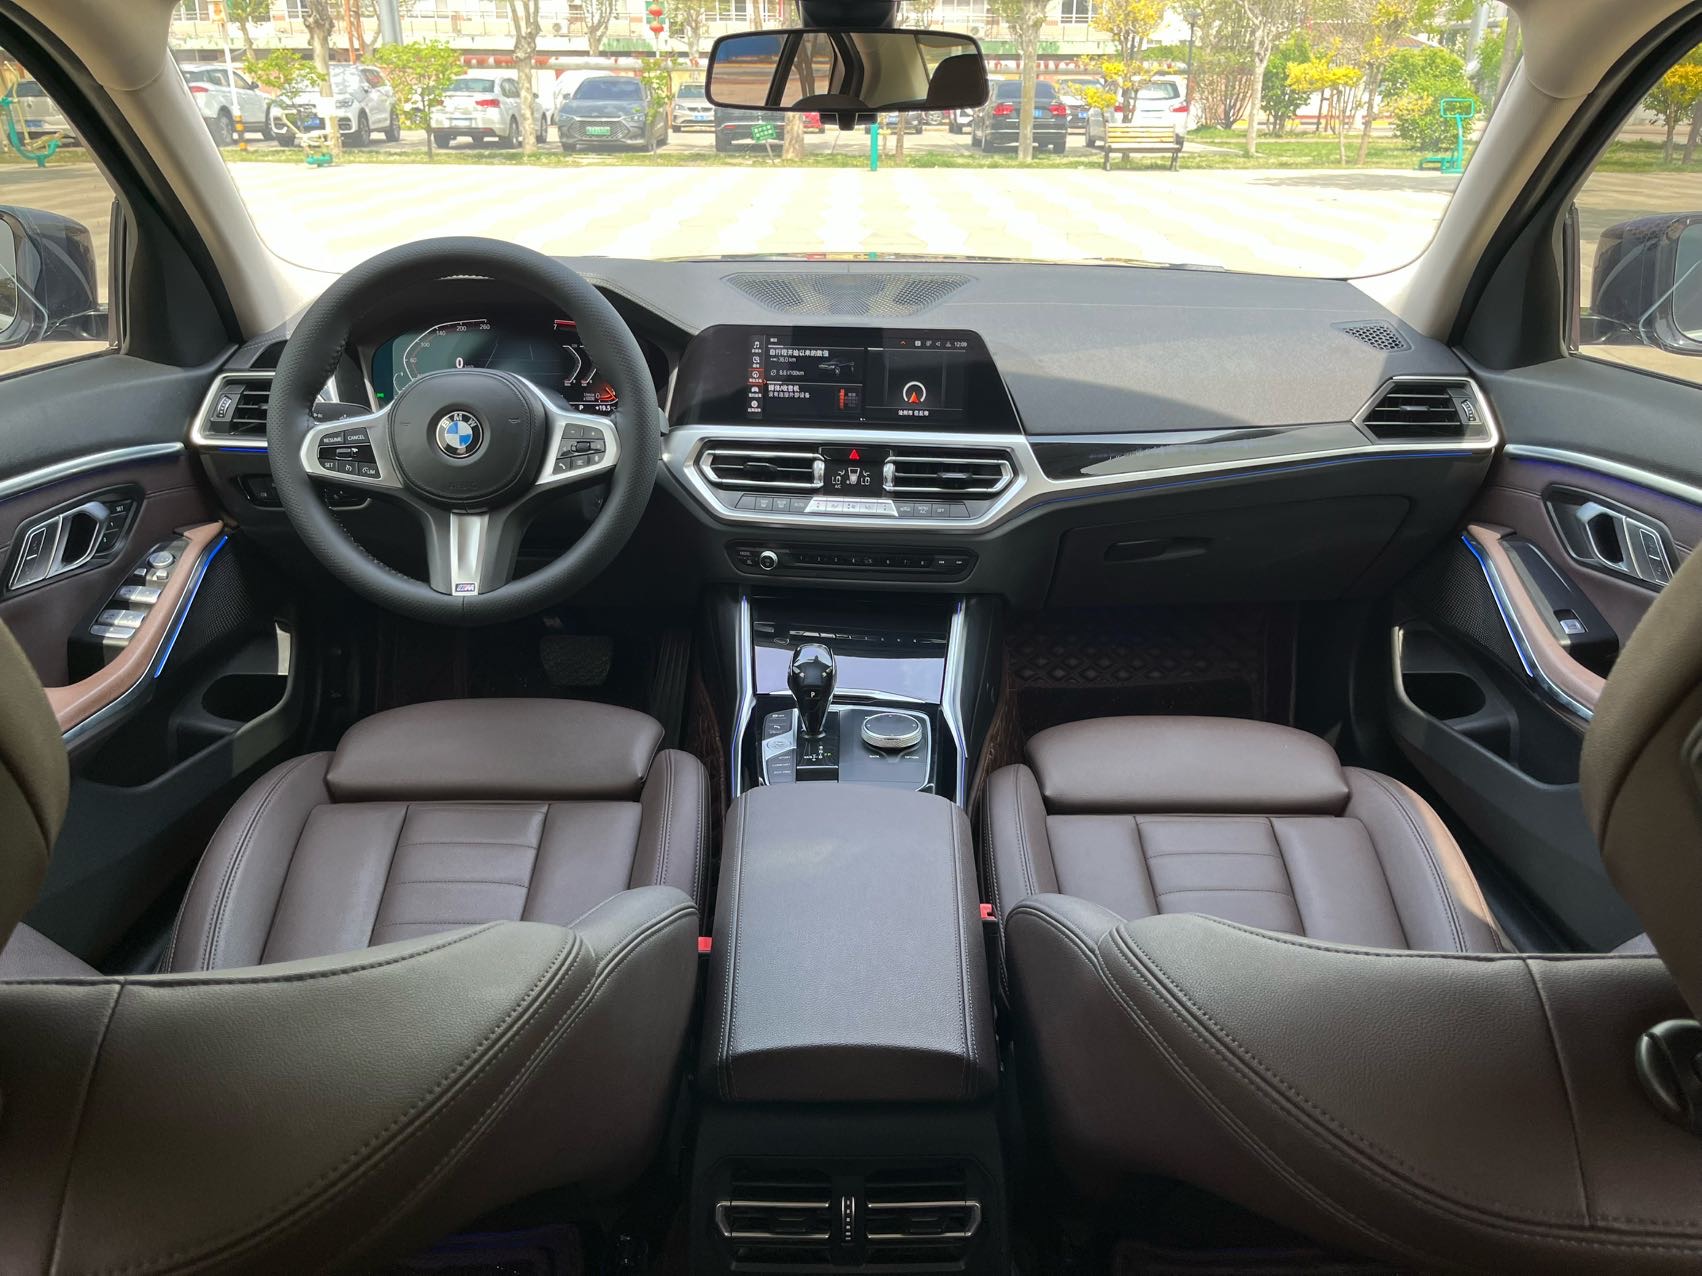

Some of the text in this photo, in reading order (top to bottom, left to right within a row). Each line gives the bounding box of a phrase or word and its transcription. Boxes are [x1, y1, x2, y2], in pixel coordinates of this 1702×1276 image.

[479, 323, 490, 331] 260
[455, 357, 464, 369] 0
[441, 413, 477, 428] BMW
[860, 477, 871, 485] LO
